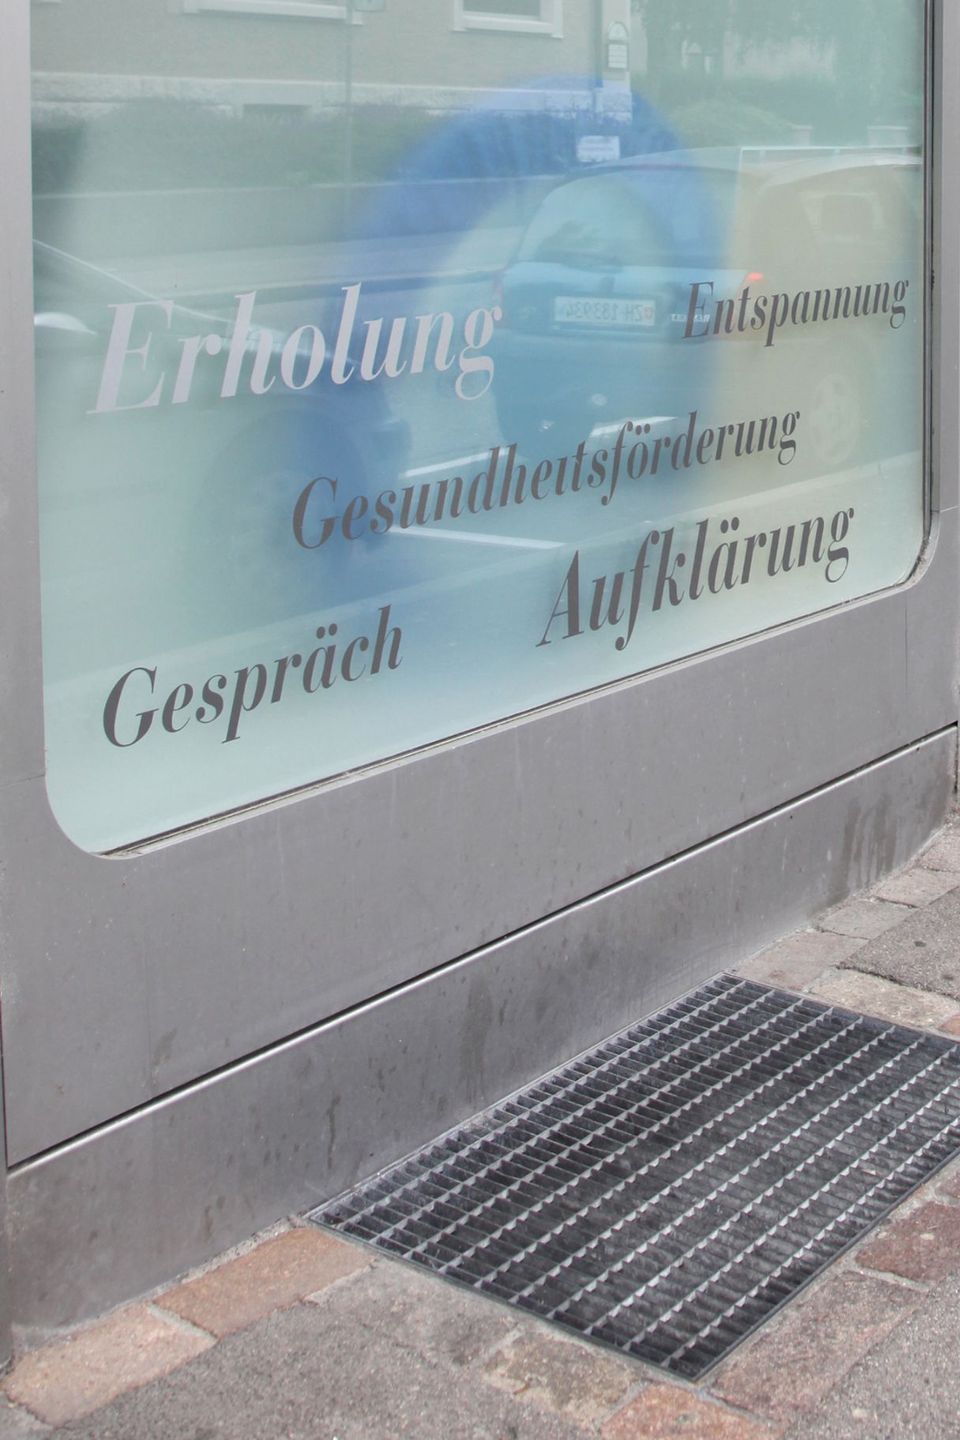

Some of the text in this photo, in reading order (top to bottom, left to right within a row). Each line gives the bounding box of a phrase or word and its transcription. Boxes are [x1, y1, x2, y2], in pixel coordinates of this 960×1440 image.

[86, 283, 503, 415] Erholung
[683, 276, 910, 348] Entspannung
[291, 409, 801, 550] Gesundheitsförderung
[536, 505, 855, 650] Aufklärung
[102, 604, 403, 748] Gespräch
